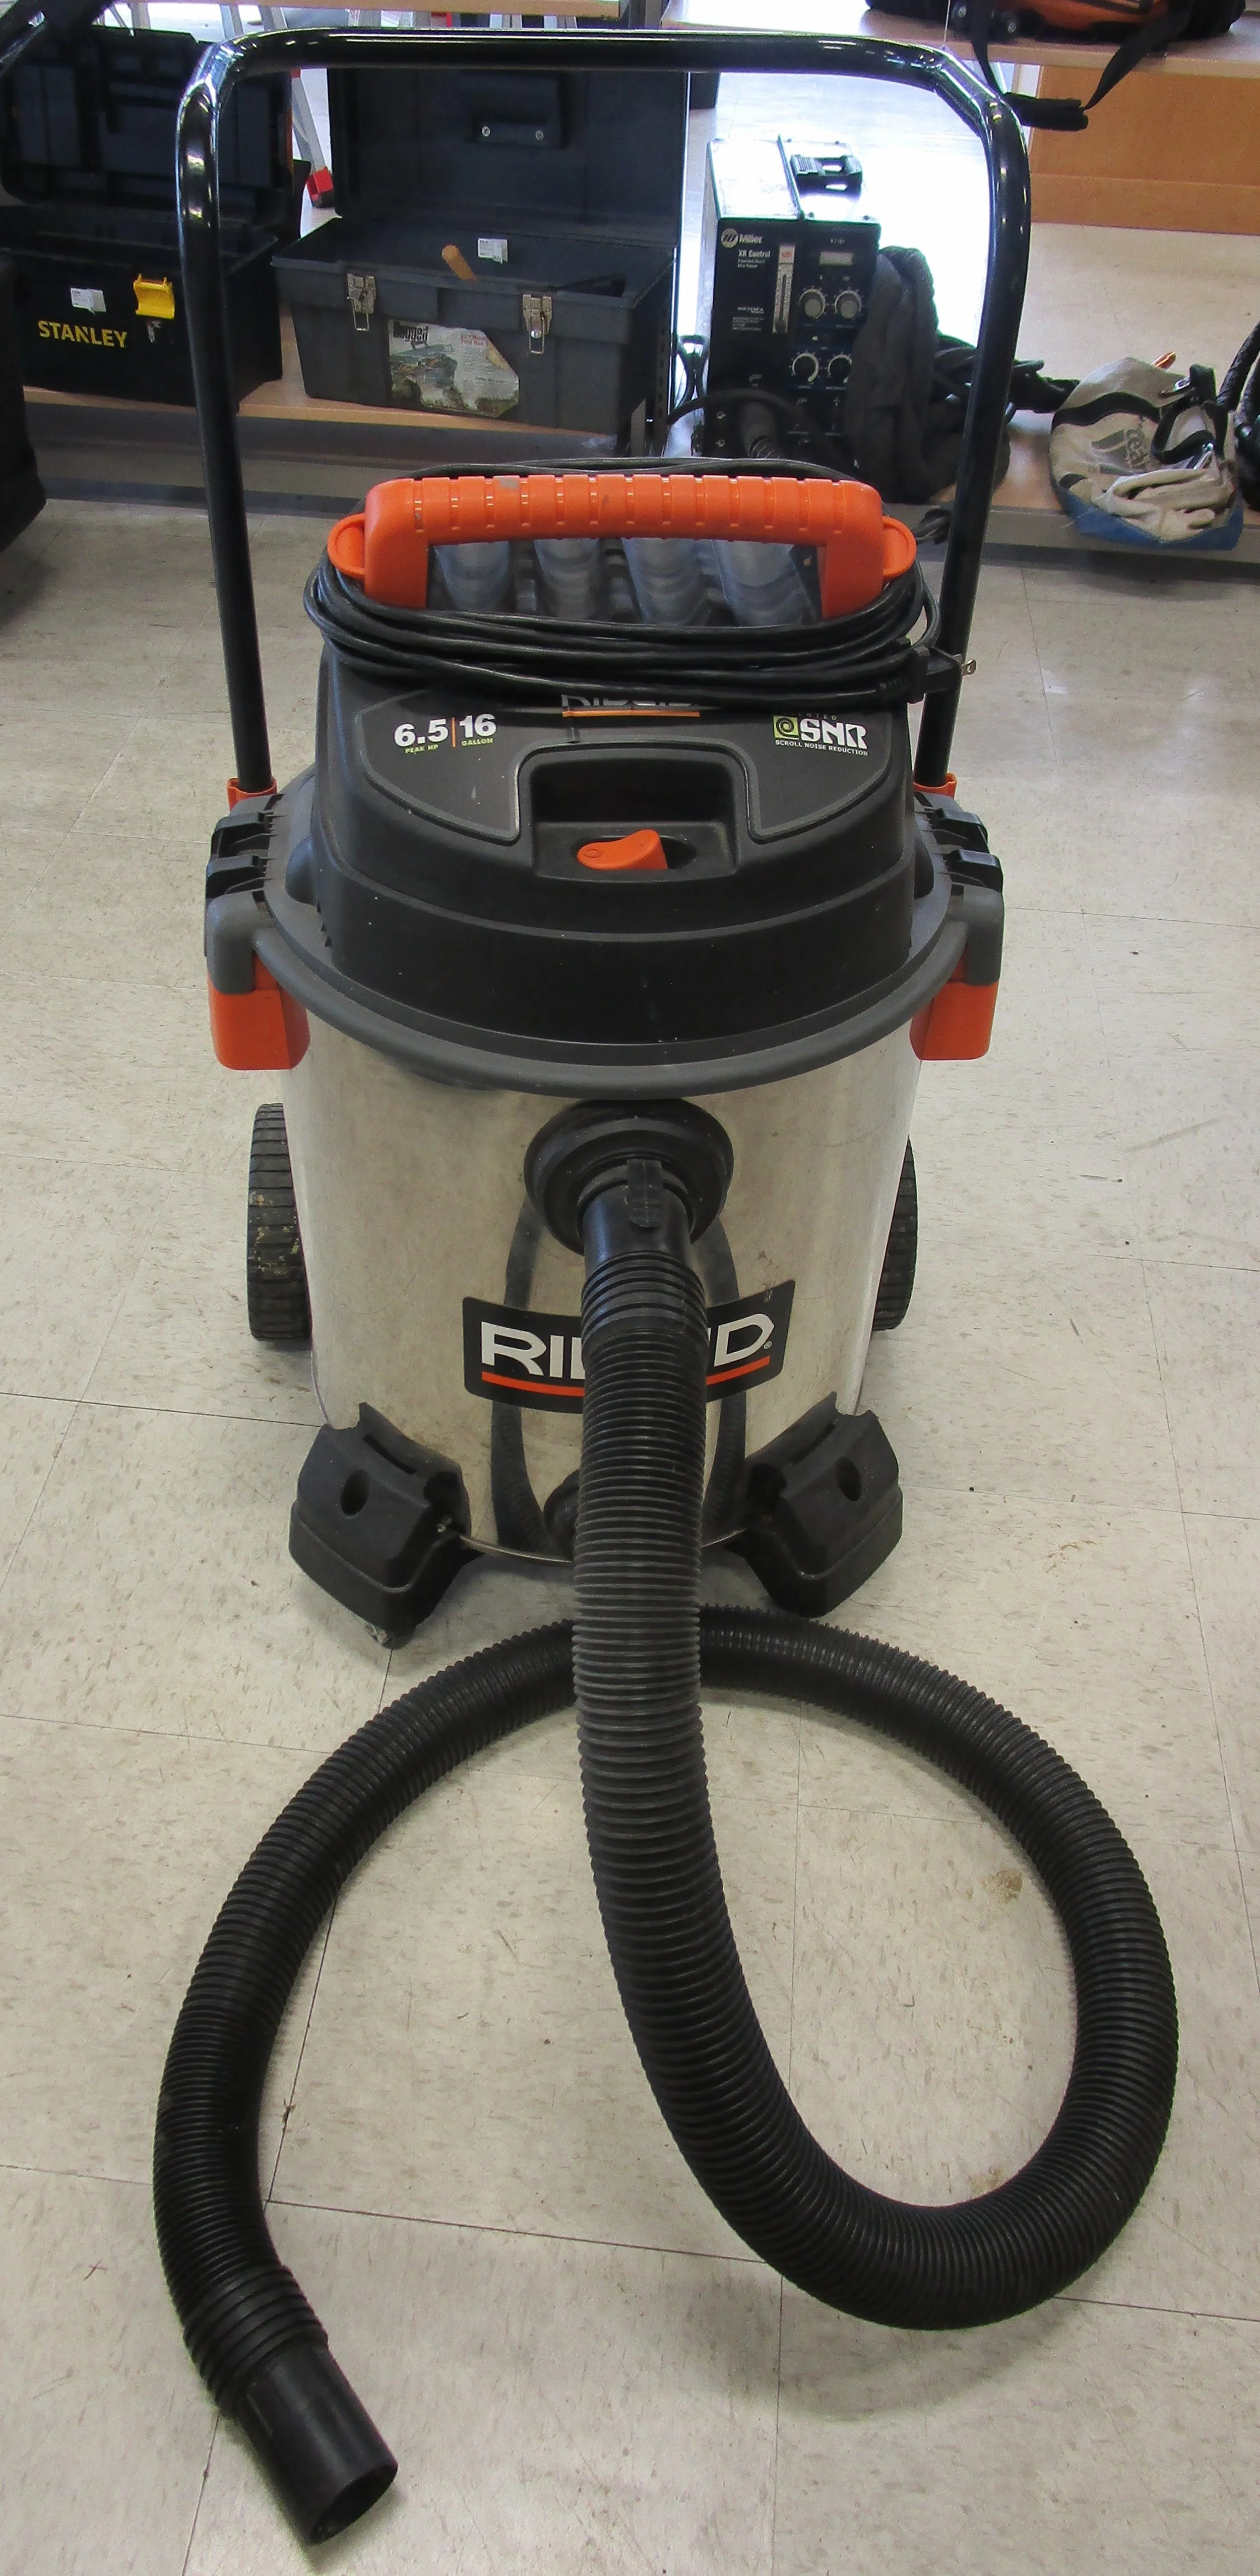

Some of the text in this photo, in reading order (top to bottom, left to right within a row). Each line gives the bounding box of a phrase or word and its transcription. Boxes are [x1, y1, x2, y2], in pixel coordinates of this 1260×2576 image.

[739, 233, 763, 243] Miller
[37, 320, 127, 348] STANLEY
[394, 714, 496, 747] 6.5 16
[800, 718, 867, 749] SNR
[461, 738, 493, 746] GALLON
[405, 745, 425, 754] PEAK
[829, 746, 868, 756] REDUCTION
